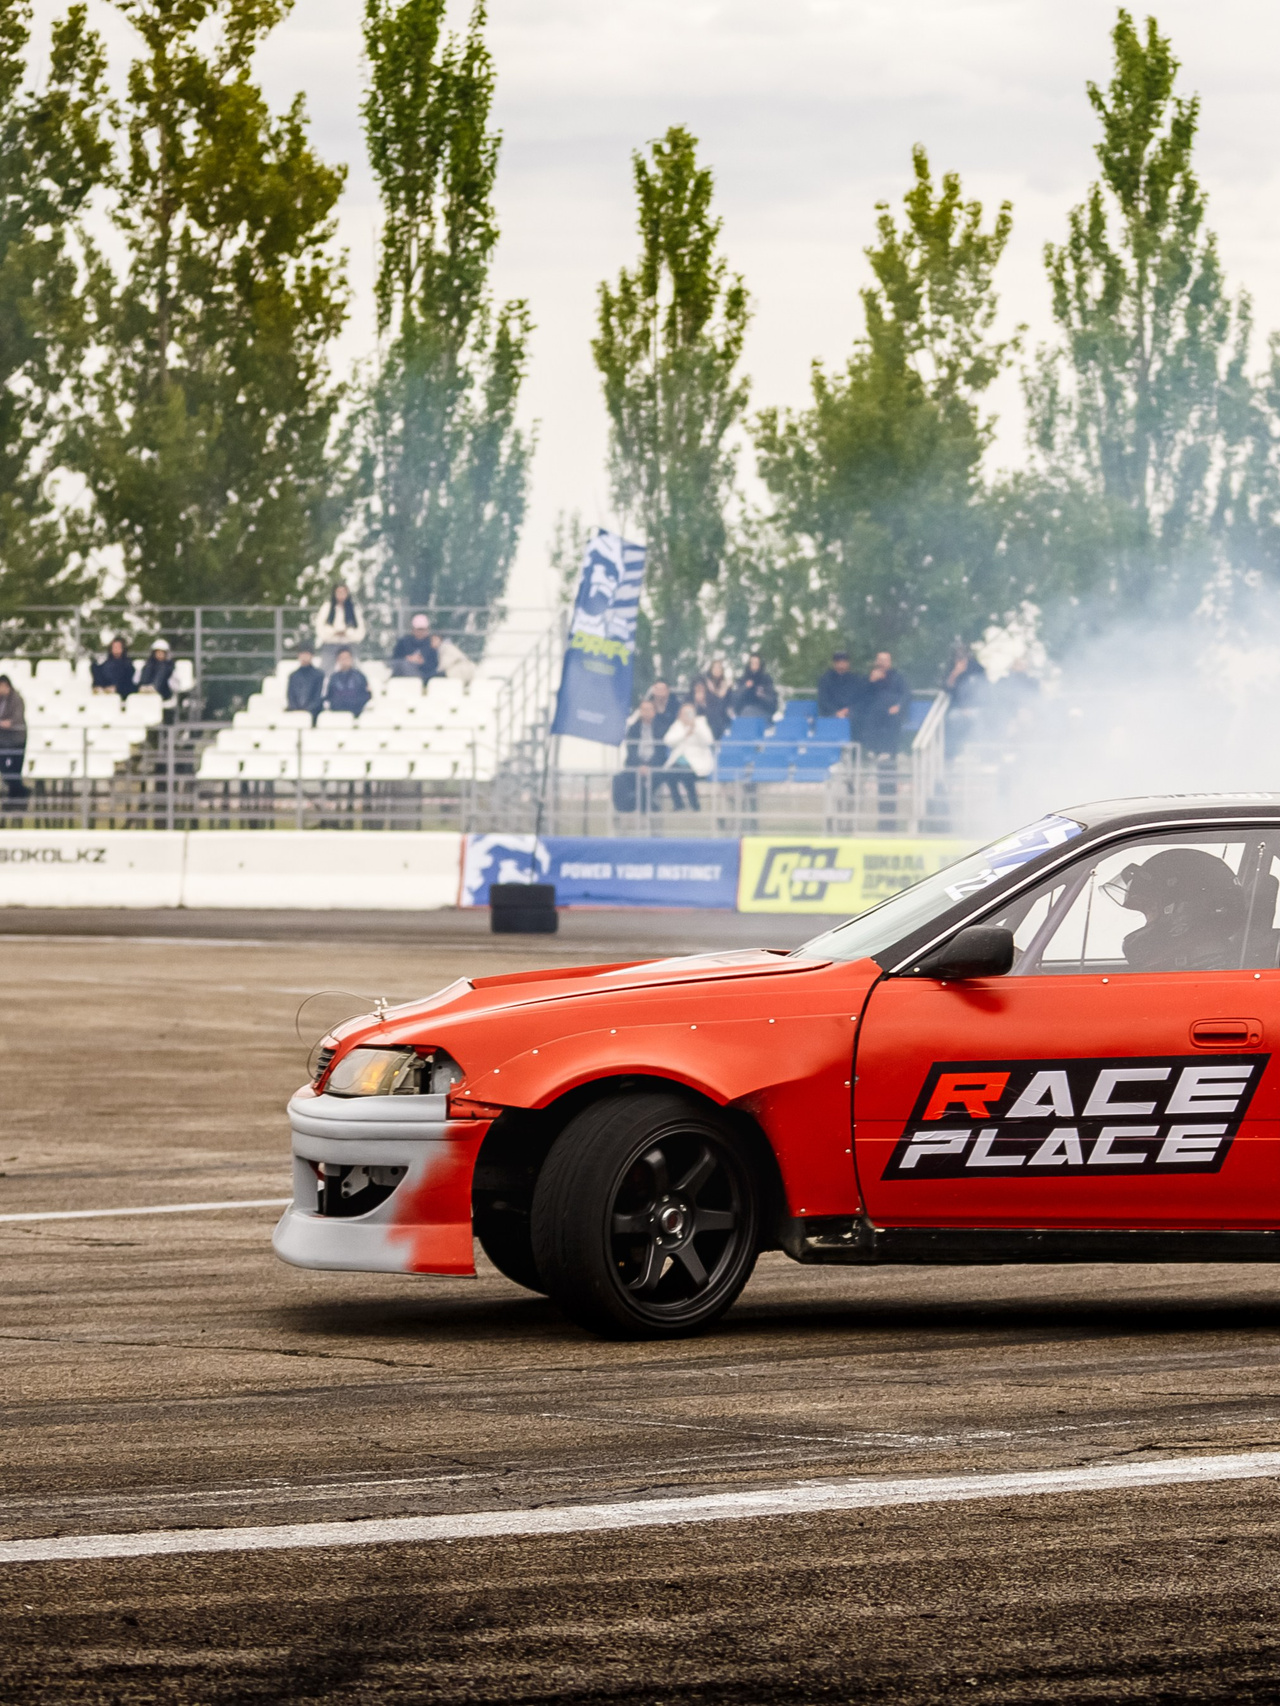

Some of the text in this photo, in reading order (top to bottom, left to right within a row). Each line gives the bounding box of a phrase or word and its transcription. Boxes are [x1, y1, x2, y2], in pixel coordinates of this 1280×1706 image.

[560, 862, 722, 881] POWER YOUR INSTINCT
[922, 1065, 1254, 1120] RACE
[899, 1124, 1228, 1169] PLACE
